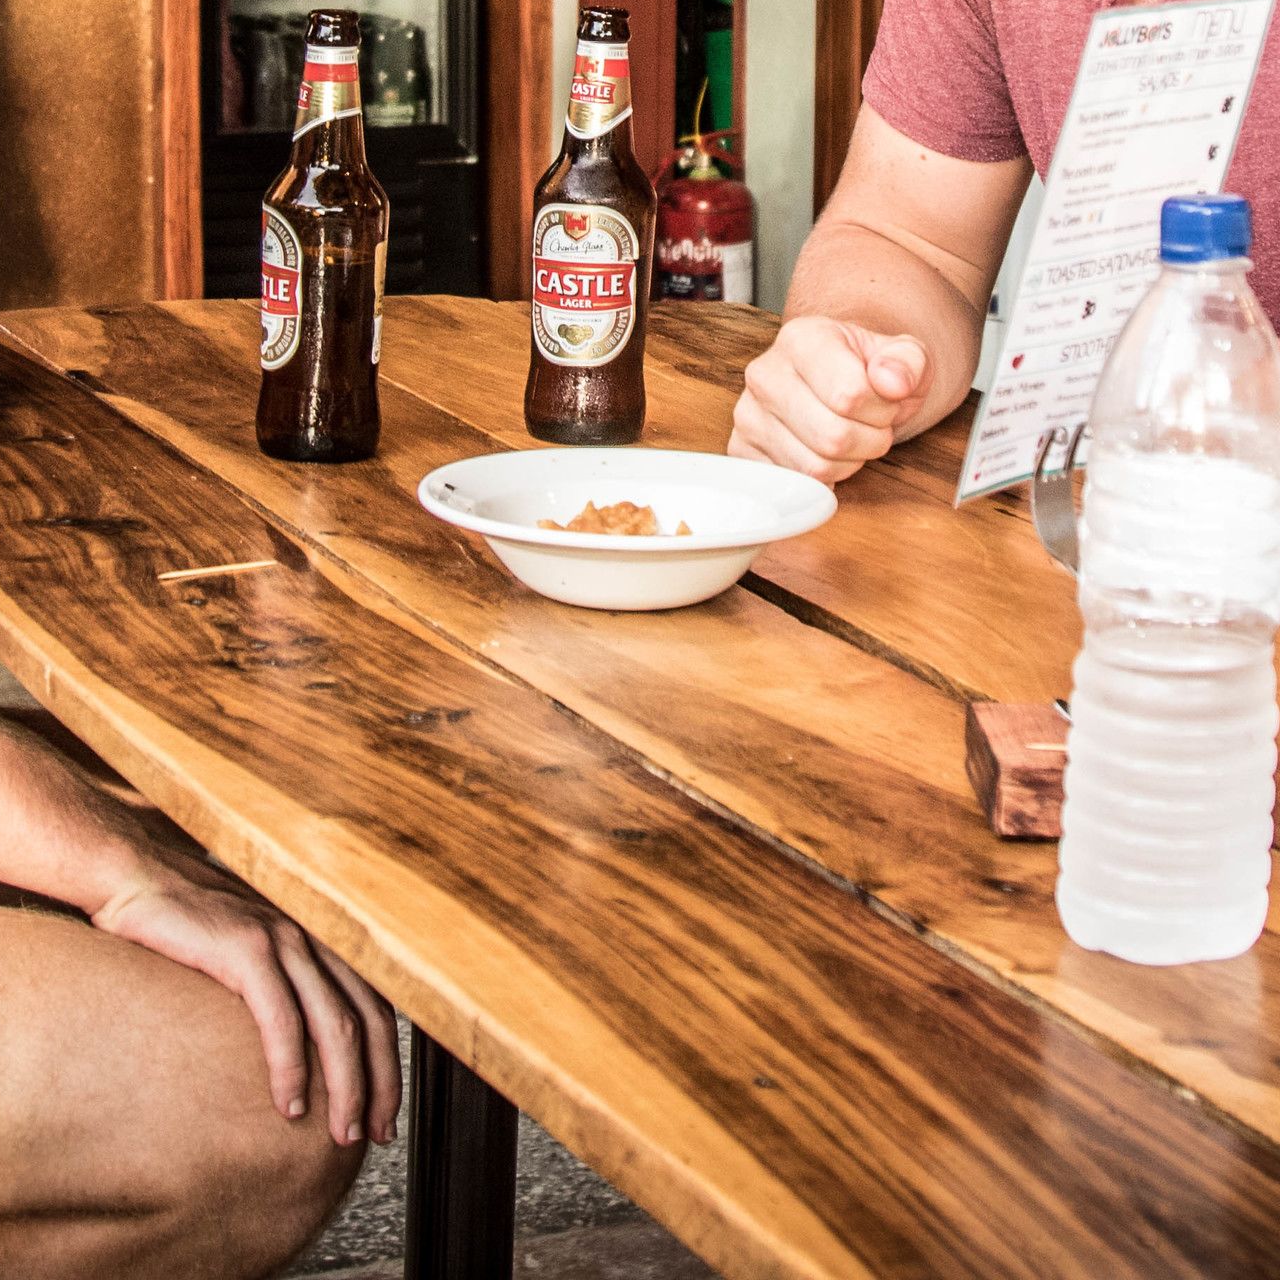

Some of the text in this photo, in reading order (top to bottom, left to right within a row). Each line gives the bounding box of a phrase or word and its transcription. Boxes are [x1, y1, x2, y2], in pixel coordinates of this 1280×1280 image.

[1098, 22, 1173, 48] JOLLYBOYS
[572, 82, 611, 98] CASTLE
[262, 274, 291, 303] TLE
[536, 269, 625, 297] CASTLE
[560, 298, 592, 309] LAGER
